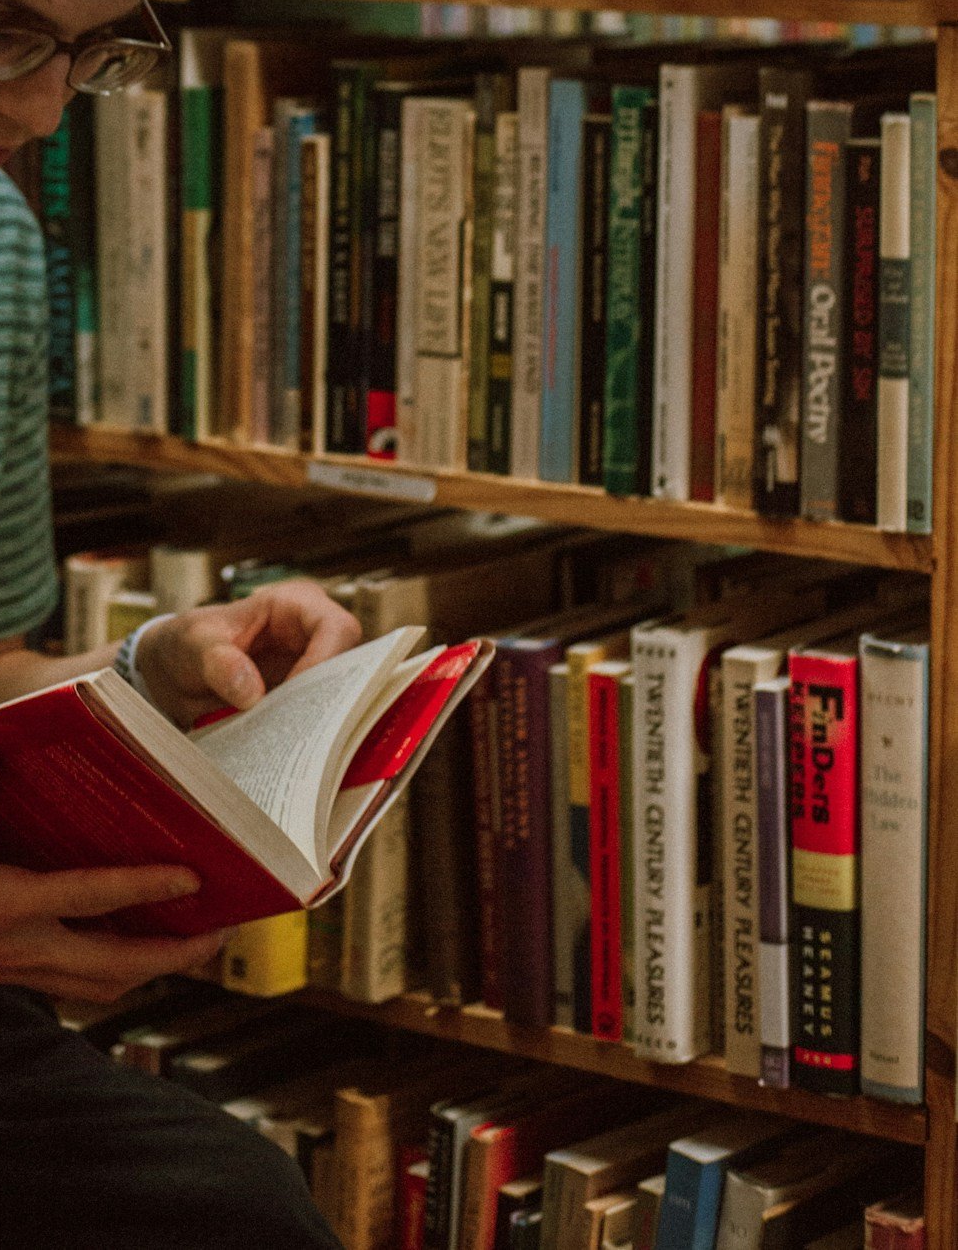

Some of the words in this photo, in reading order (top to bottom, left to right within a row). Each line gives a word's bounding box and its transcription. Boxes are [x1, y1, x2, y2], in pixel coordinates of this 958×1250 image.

[809, 283, 837, 347] Oral
[853, 206, 874, 327] SURPRISED
[853, 330, 873, 356] BY
[853, 367, 873, 400] SIN
[807, 351, 837, 444] Poetry
[646, 673, 664, 796] TWENTIETH
[733, 681, 751, 804] TWENTIETH
[872, 765, 902, 785] The
[645, 805, 665, 898] CENTURY
[734, 813, 753, 907] CENTURY
[645, 909, 665, 1025] PLEASURES
[734, 917, 754, 1035] PLEASURES
[801, 924, 815, 1037] HEANEY
[818, 929, 832, 1038] SEAMUS
